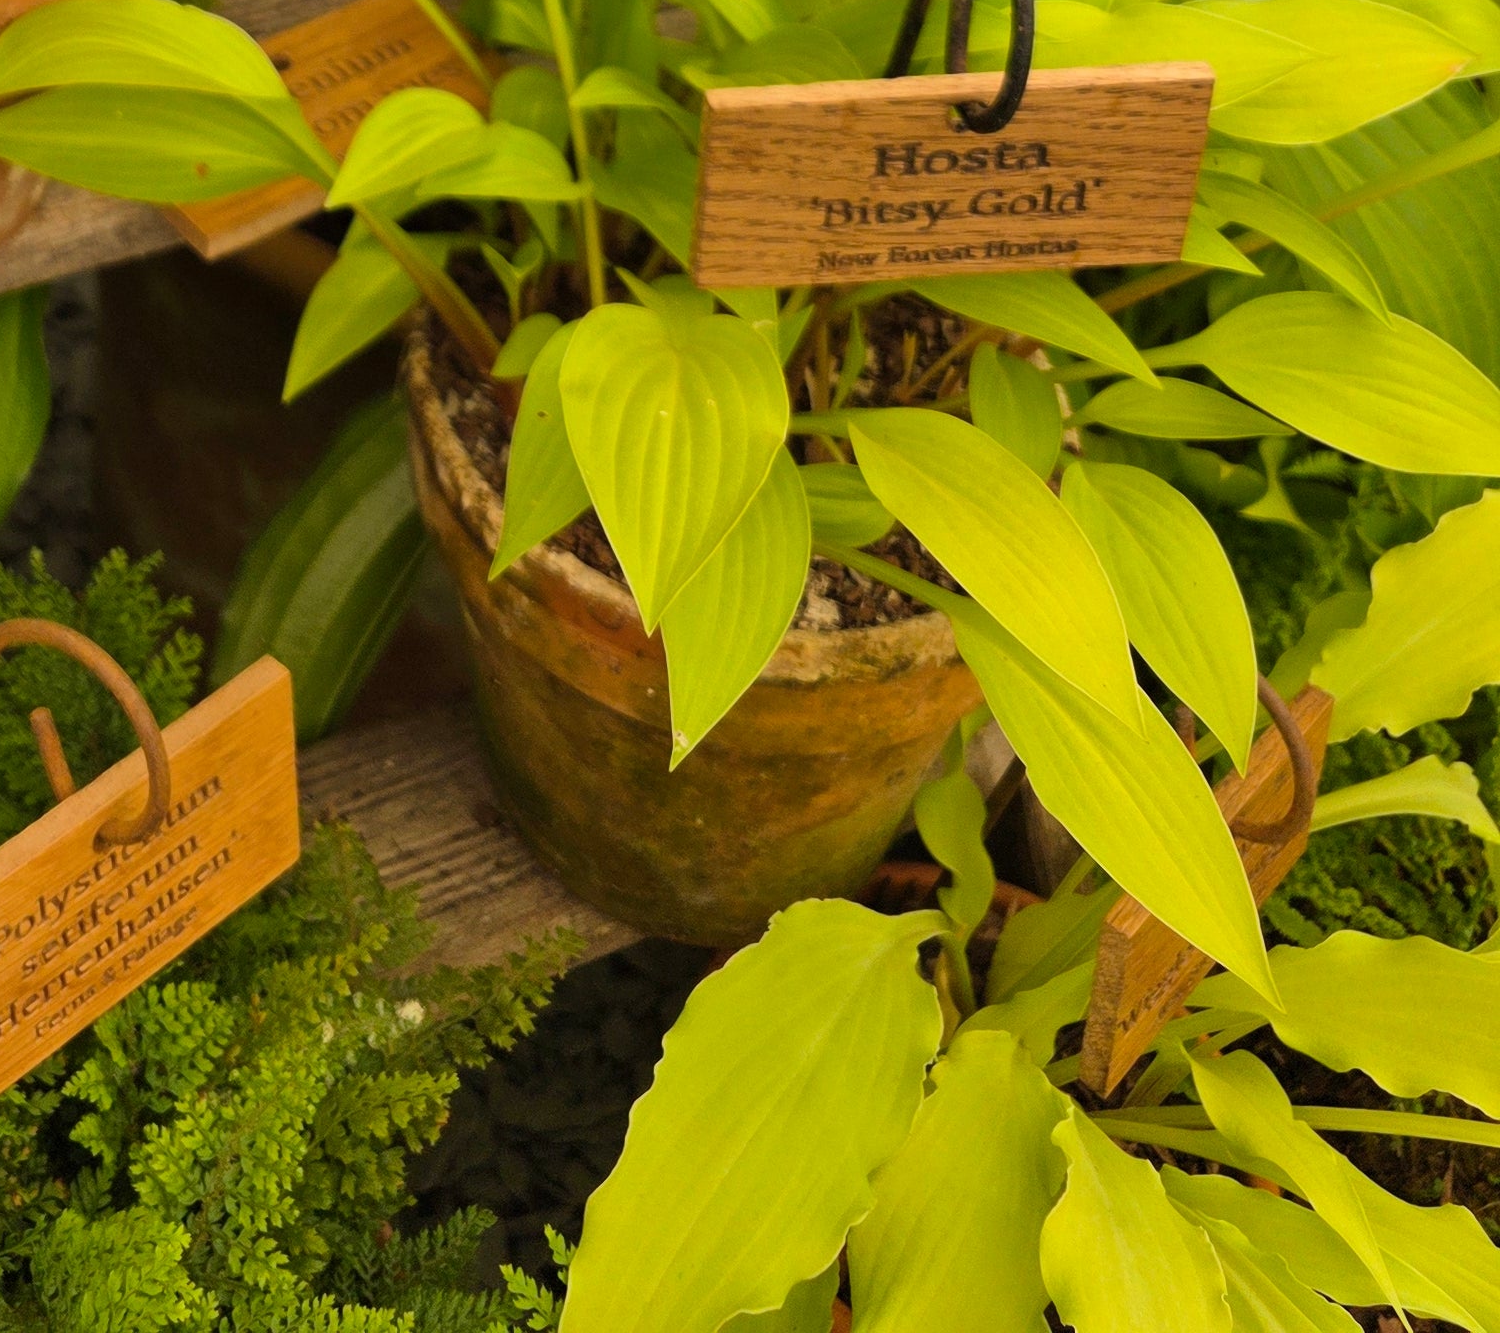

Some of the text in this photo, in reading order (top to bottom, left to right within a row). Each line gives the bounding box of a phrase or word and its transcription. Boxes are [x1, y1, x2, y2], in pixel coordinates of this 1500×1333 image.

[873, 140, 1051, 177] Hosta
[810, 179, 1102, 233] 'Bitsy Gold'
[817, 238, 1080, 270] New Forest Hostas
[34, 986, 96, 1039] Ferns
